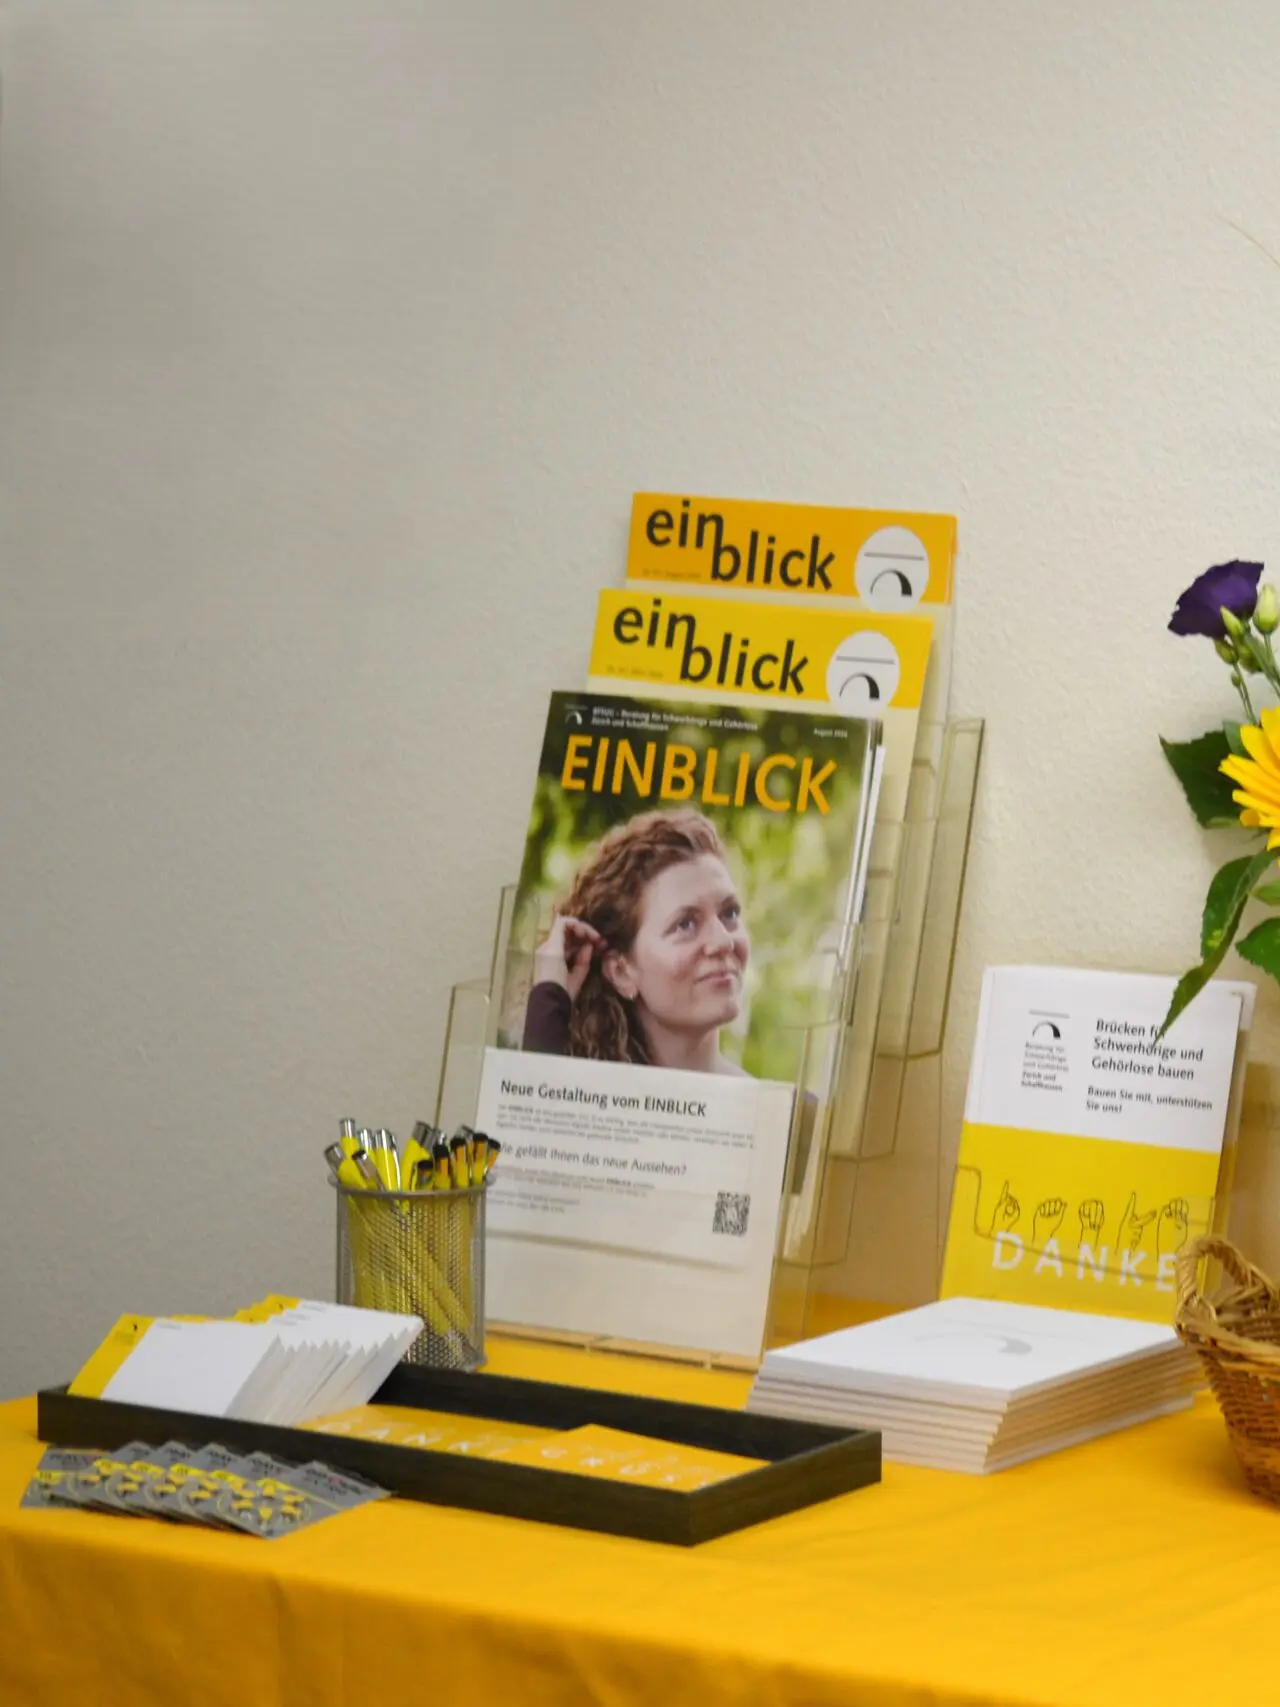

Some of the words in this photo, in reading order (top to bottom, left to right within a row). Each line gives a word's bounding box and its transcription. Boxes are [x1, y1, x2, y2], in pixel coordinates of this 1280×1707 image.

[561, 734, 838, 815] EINBLICK
[1096, 1019, 1146, 1037] Brücken
[1094, 1037, 1176, 1060] Schwerhörige
[1180, 1048, 1204, 1062] und
[1091, 1058, 1154, 1076] Gehörlose
[1158, 1065, 1195, 1081] bauen
[500, 1080, 534, 1098] Neue
[538, 1083, 608, 1110] Gestaltung
[612, 1095, 640, 1110] vom
[644, 1096, 707, 1118] EINBLICK
[1086, 1101, 1100, 1113] Sie
[1087, 1086, 1117, 1100] Bauen
[1120, 1089, 1134, 1101] Sie
[1156, 1095, 1213, 1111] unterstützen
[516, 1144, 548, 1162] gefällt
[583, 1151, 600, 1167] das
[603, 1157, 628, 1170] neue
[631, 1158, 687, 1176] Aussehen?
[991, 1231, 1177, 1292] DANKE
